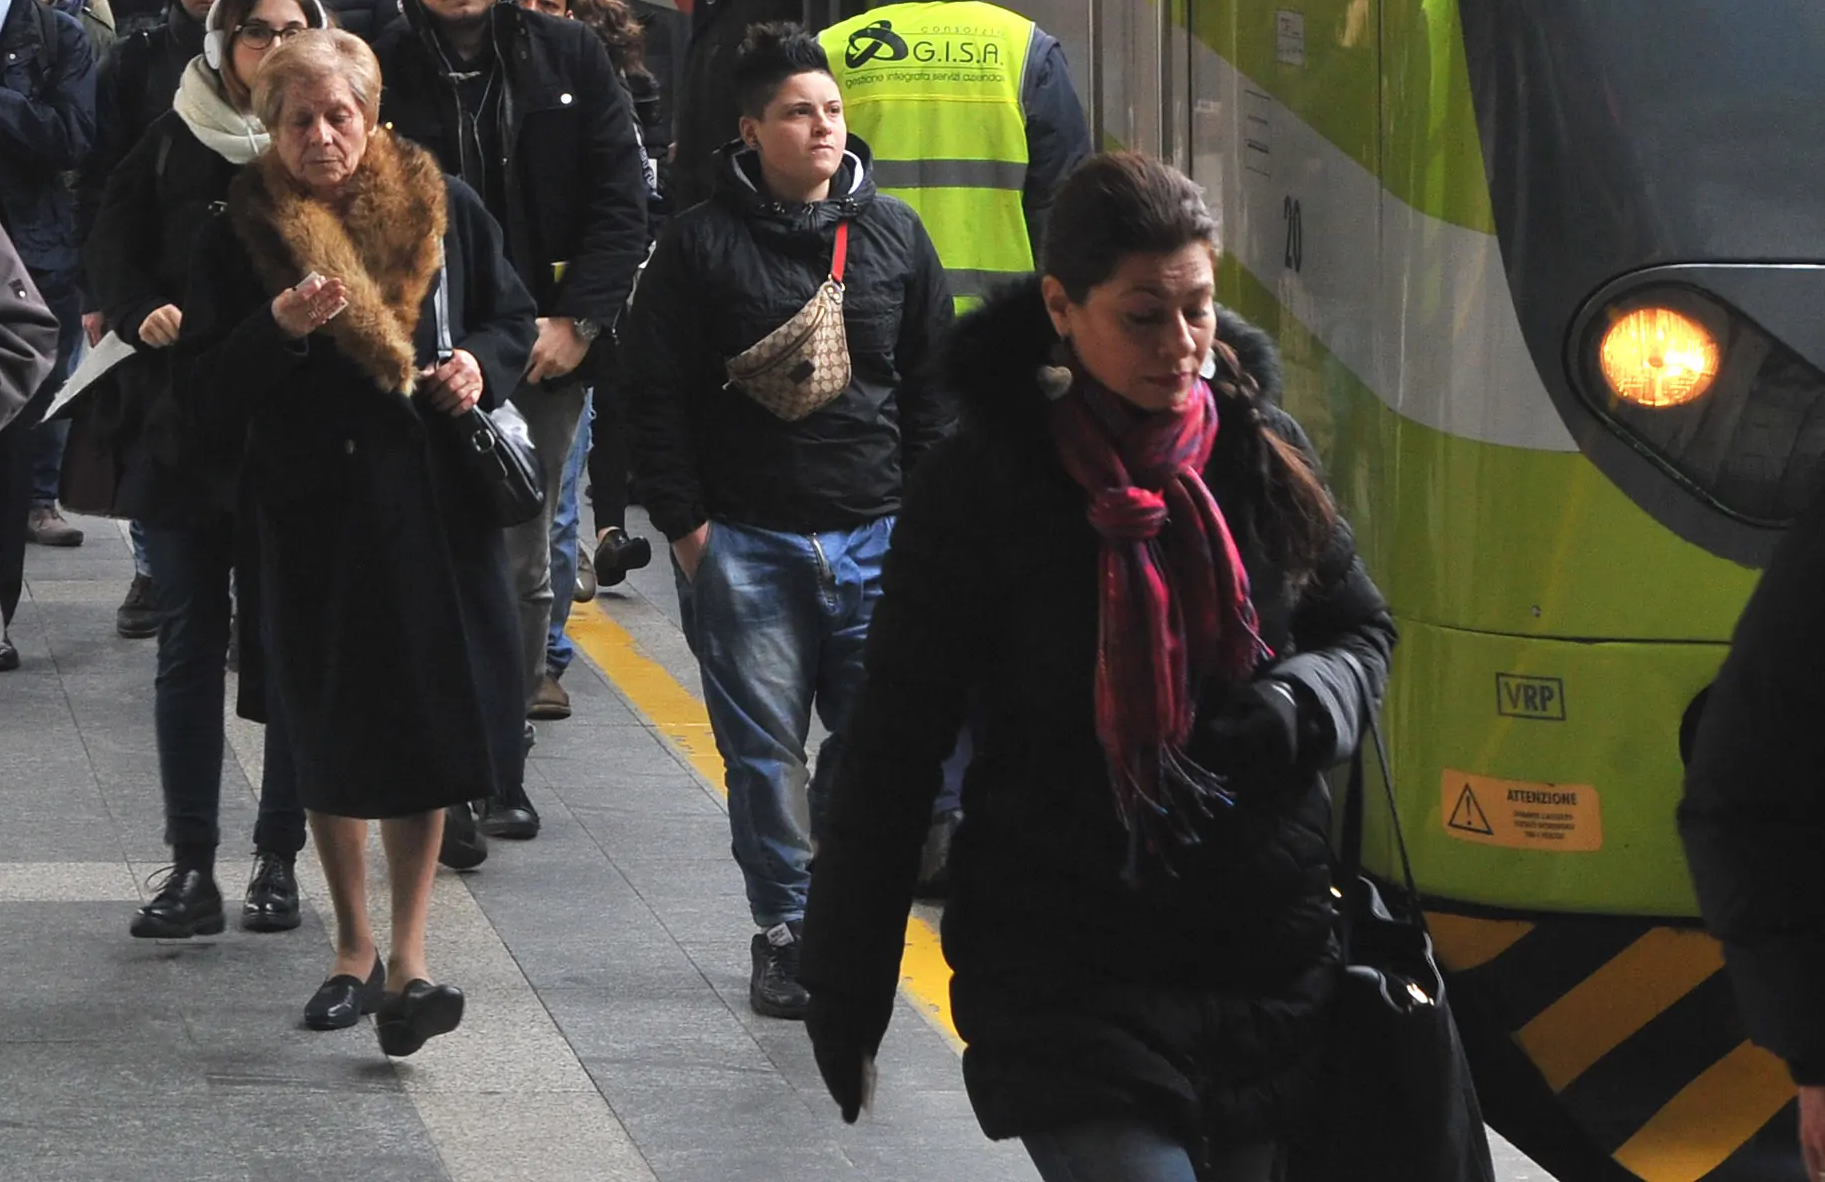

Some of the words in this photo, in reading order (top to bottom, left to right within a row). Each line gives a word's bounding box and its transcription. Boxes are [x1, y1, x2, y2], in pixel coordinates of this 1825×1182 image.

[913, 40, 1004, 66] G.I.S.A.
[1283, 194, 1302, 274] 20
[1504, 681, 1555, 712] VRP
[1507, 788, 1577, 806] ATTENZIONE
